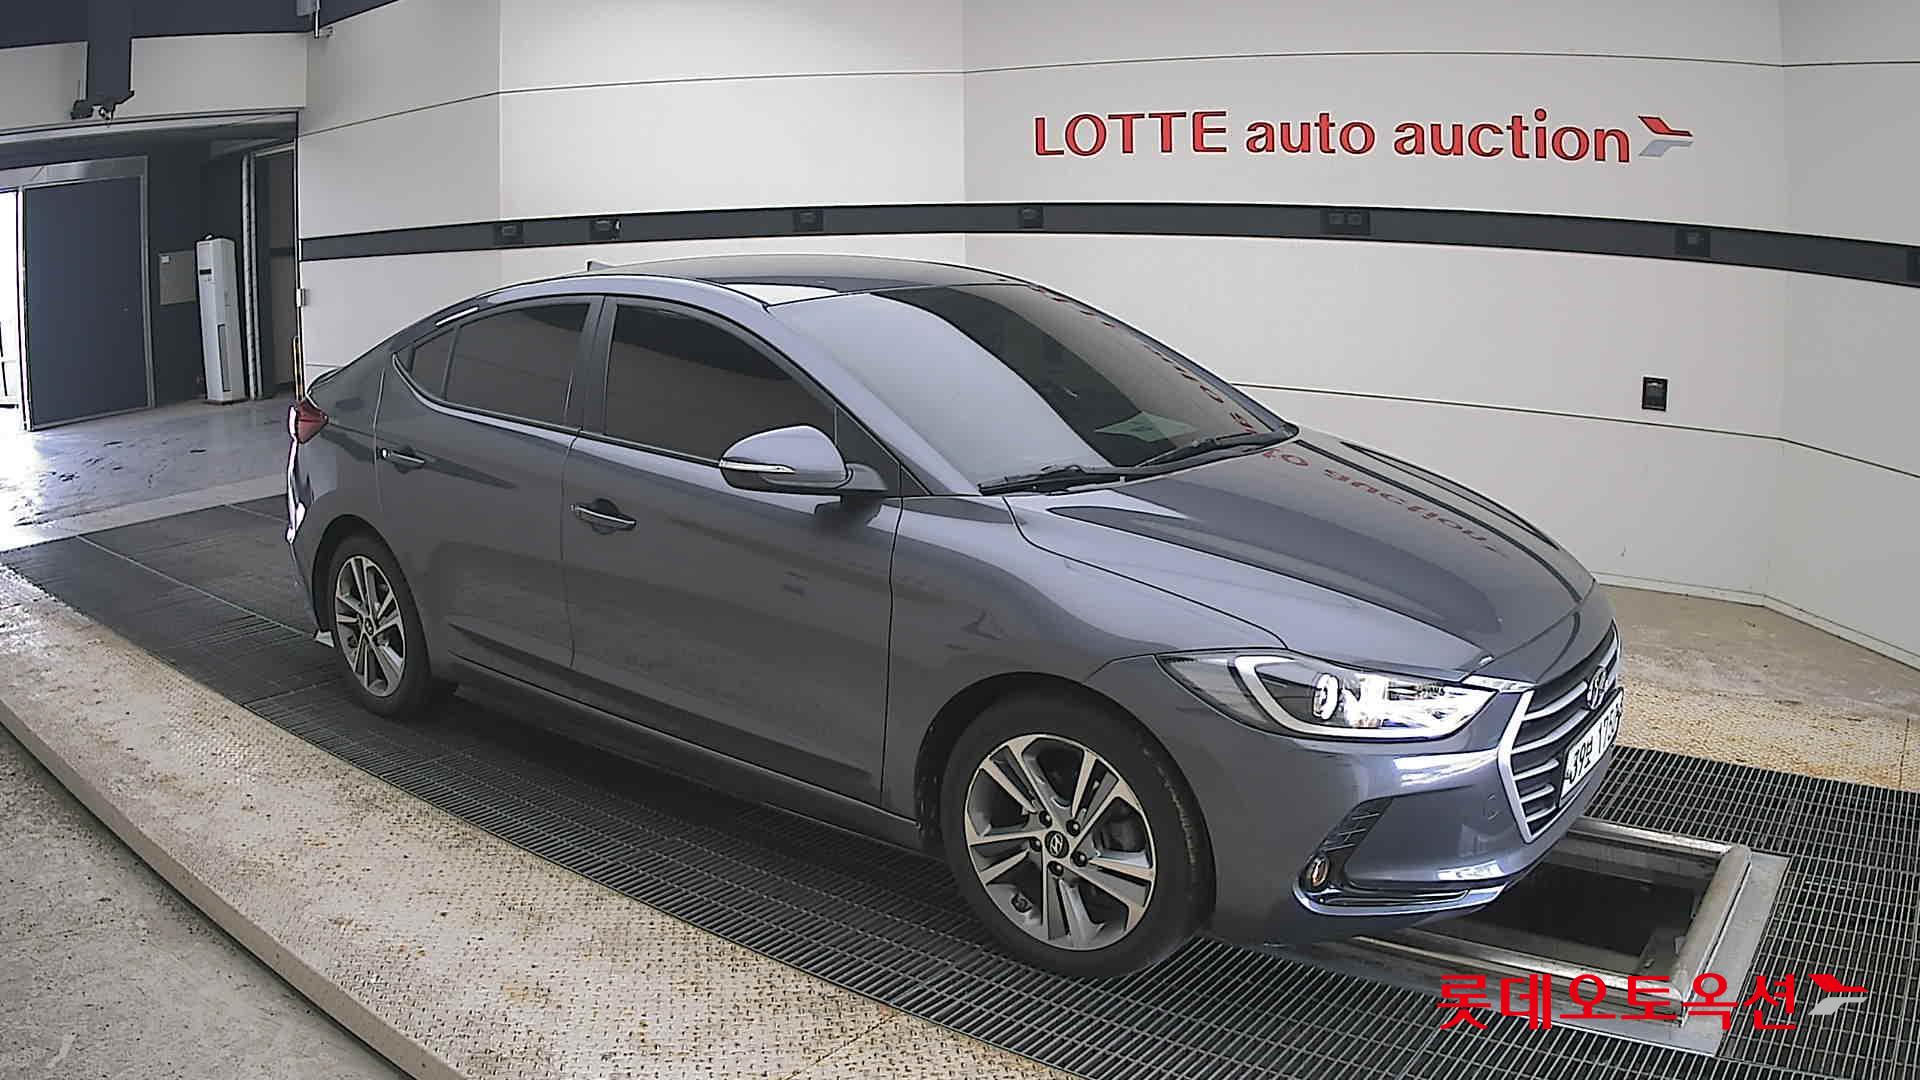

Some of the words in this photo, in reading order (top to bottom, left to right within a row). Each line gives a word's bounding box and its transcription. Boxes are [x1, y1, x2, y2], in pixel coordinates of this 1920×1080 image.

[1034, 110, 1227, 156] LOTTE
[1246, 112, 1375, 154] auto
[1393, 108, 1630, 163] auction
